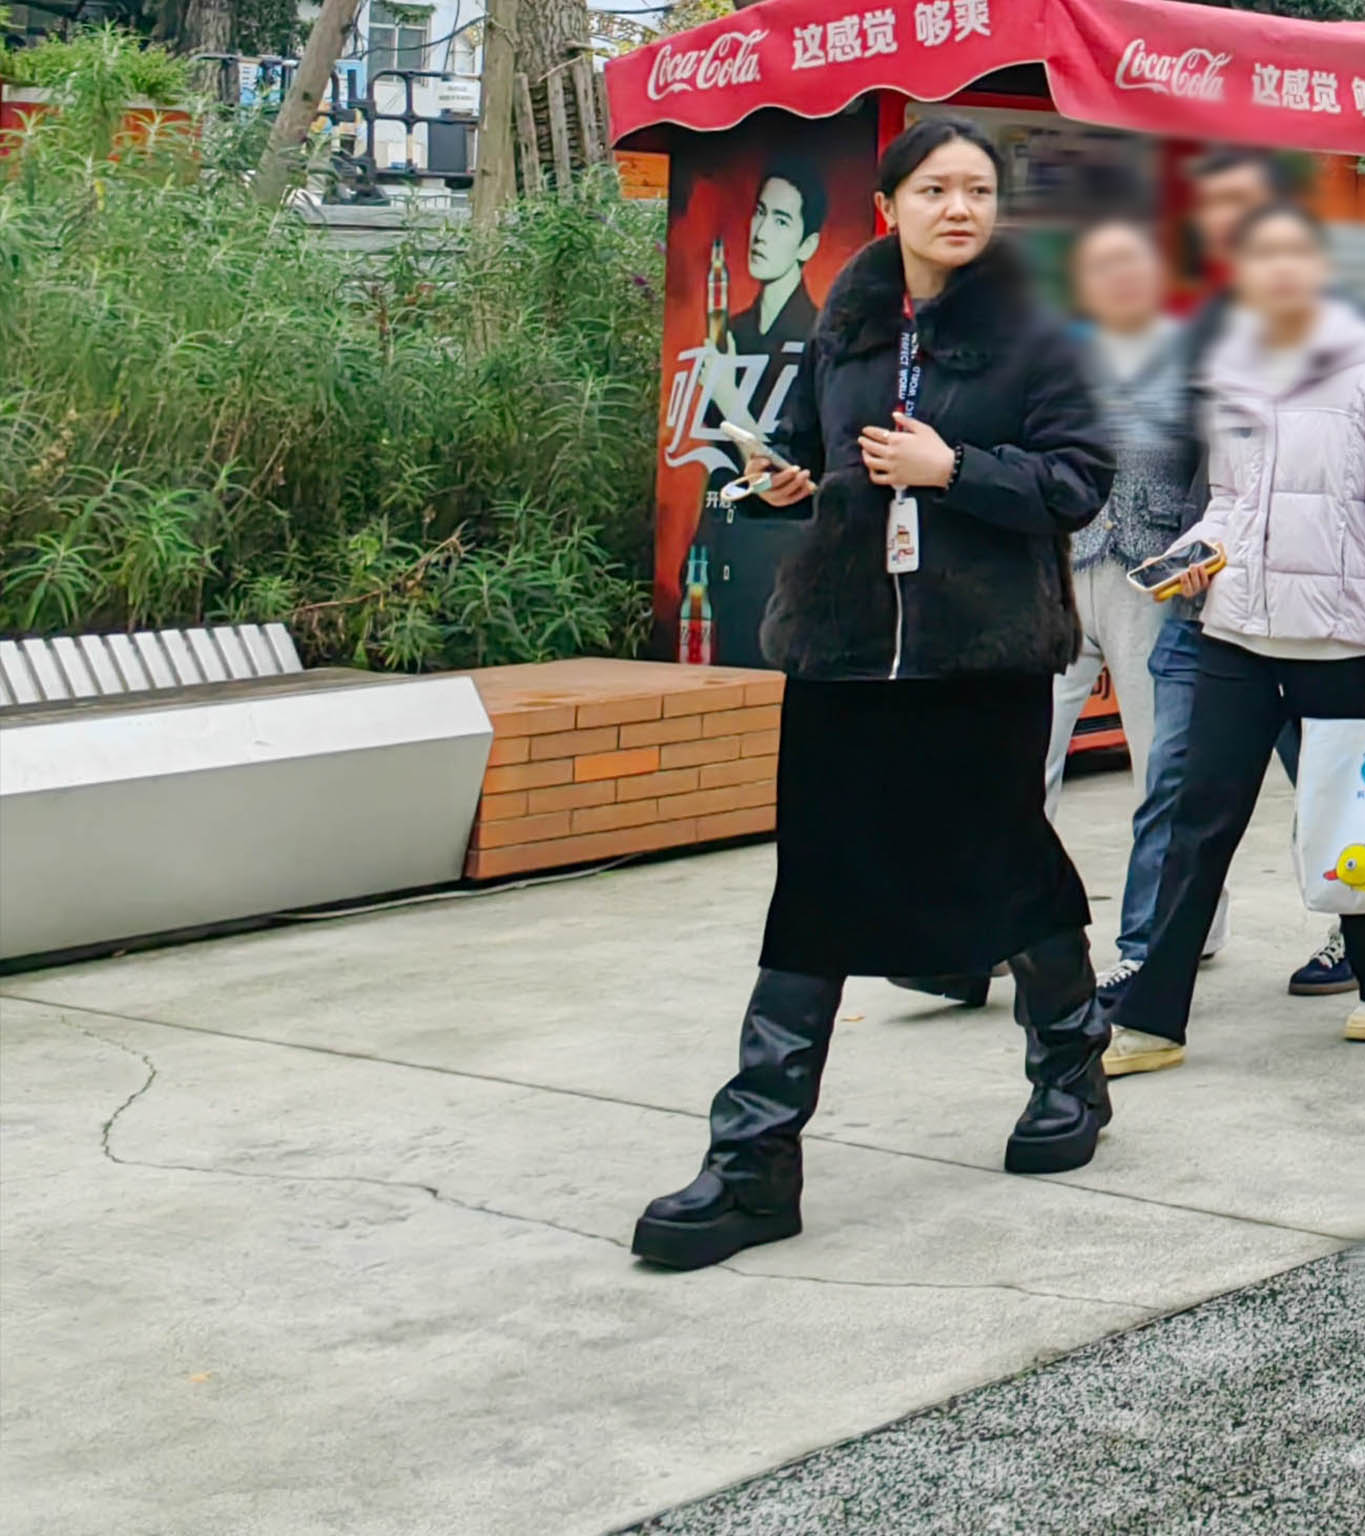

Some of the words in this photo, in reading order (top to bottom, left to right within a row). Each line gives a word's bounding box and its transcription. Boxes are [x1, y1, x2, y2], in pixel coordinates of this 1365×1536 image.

[647, 28, 770, 100] Coca-Cola
[792, 9, 897, 70] 这感觉
[1252, 62, 1342, 114] 这感觉
